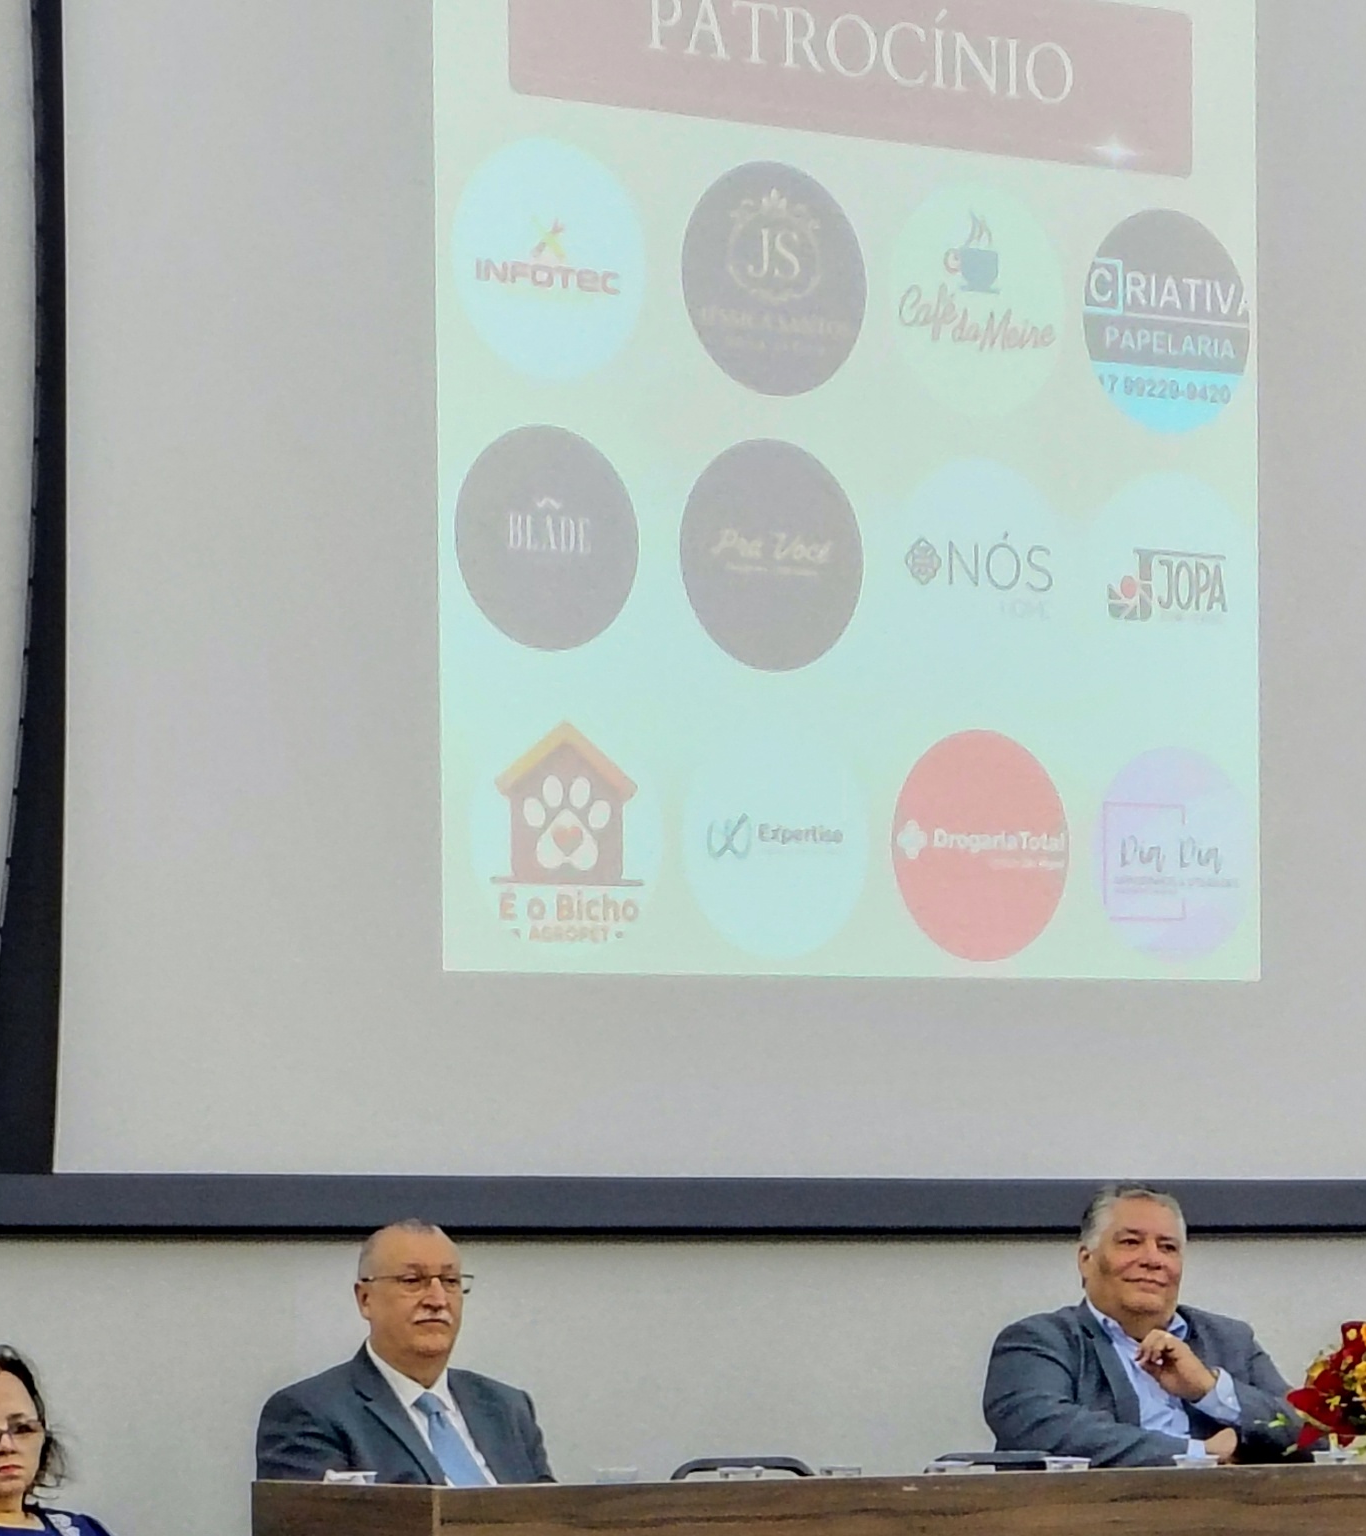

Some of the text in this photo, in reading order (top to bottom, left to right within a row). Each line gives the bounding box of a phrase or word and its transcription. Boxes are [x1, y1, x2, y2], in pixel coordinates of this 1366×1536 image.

[647, 0, 1075, 105] PATROCÍNIO
[746, 228, 801, 280] JS
[898, 282, 959, 342] Café
[1104, 325, 1237, 360] PAPELARIA
[947, 530, 1054, 592] NÓS
[1157, 559, 1228, 613] JOPA
[527, 896, 546, 921] o
[555, 890, 640, 922] Bicho
